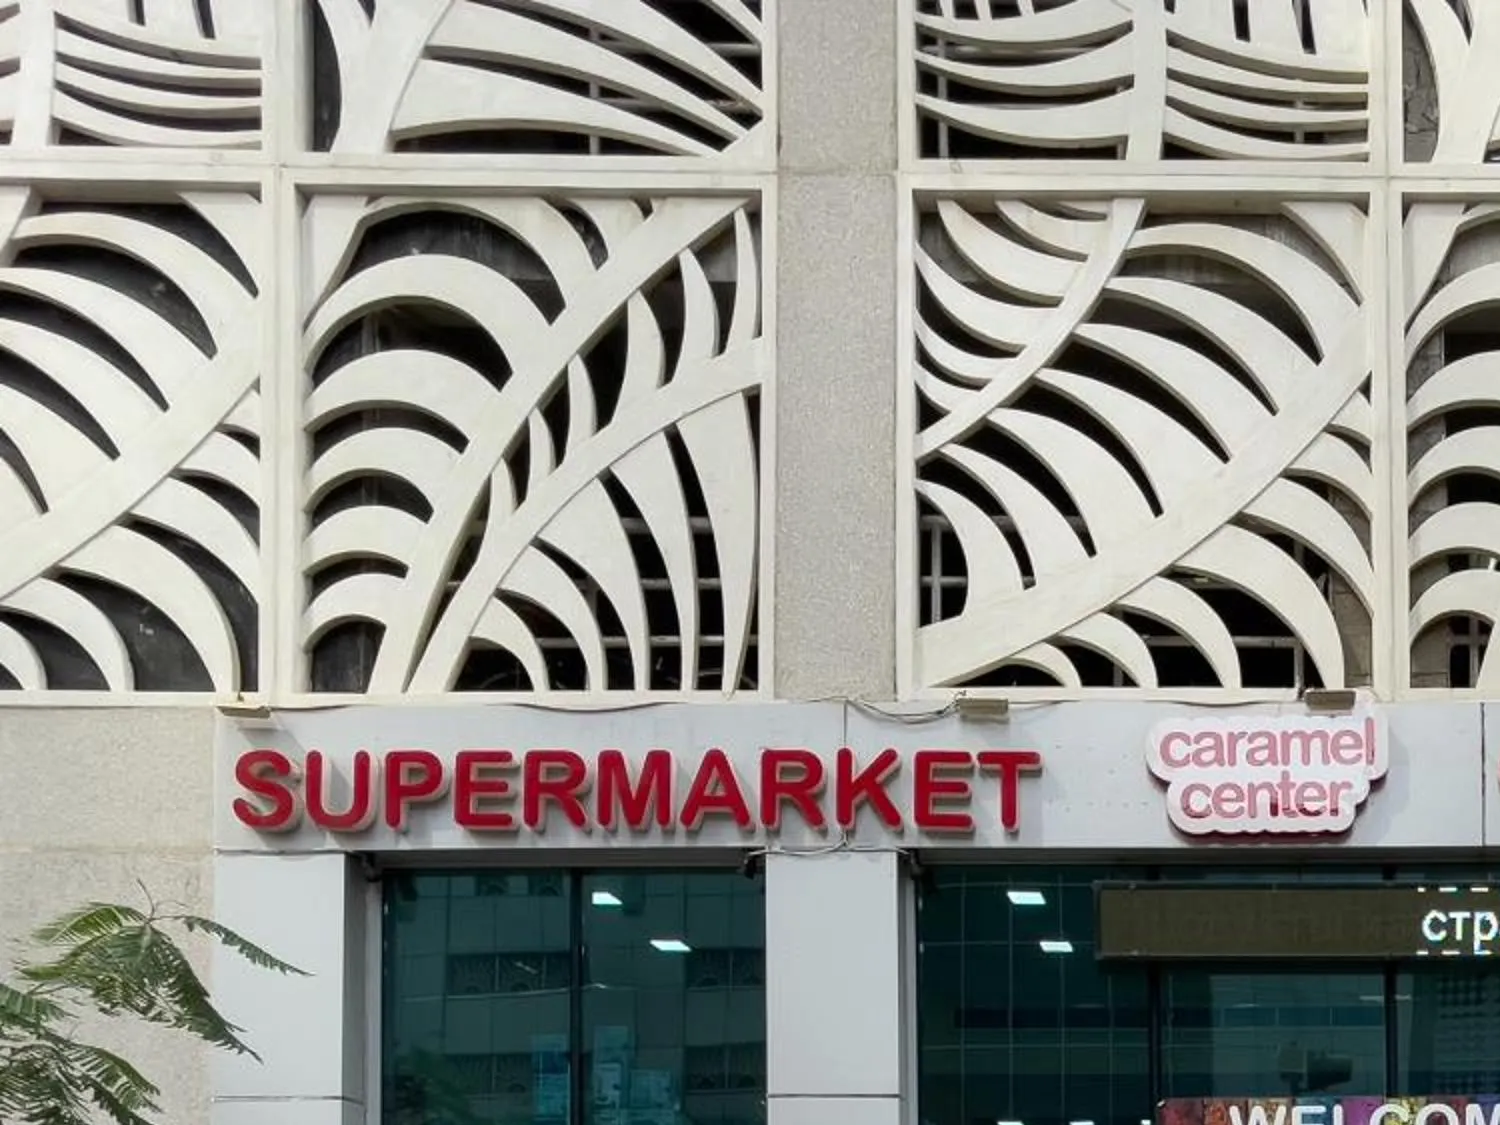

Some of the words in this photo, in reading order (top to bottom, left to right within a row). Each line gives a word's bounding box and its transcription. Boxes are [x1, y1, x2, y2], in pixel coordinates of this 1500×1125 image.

[1160, 717, 1375, 767] caramel
[232, 748, 1043, 833] SUPERMARKET
[1181, 770, 1353, 818] center
